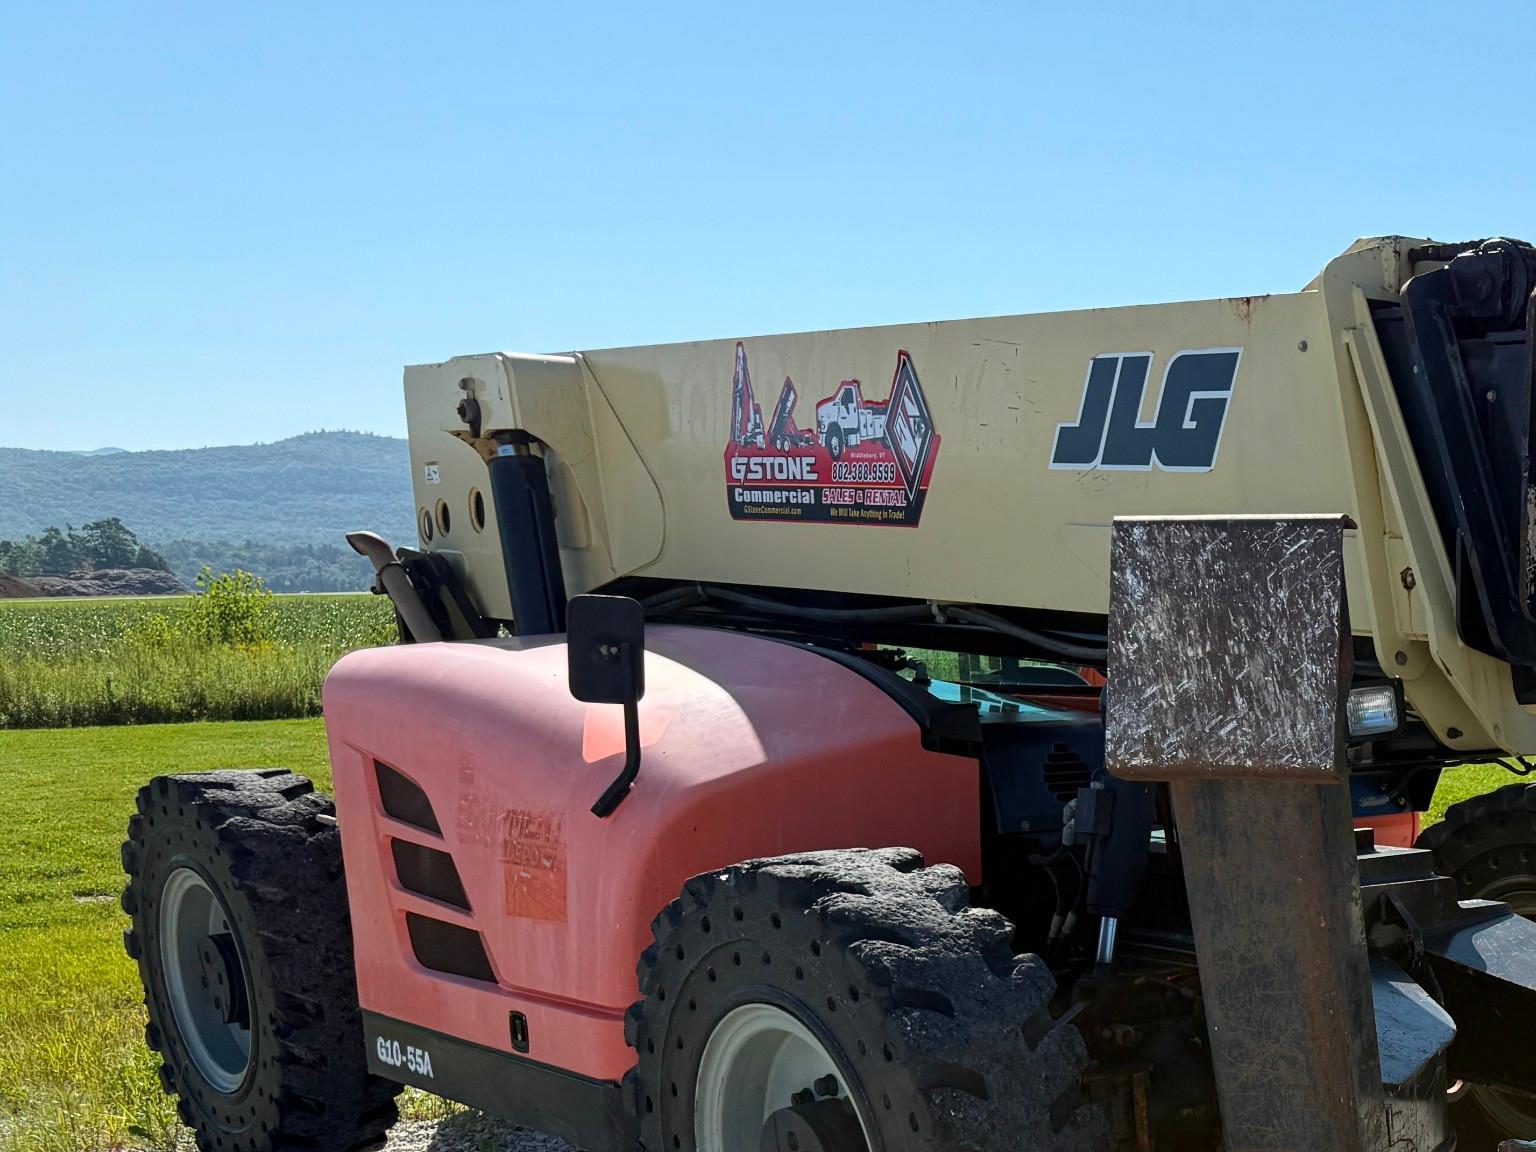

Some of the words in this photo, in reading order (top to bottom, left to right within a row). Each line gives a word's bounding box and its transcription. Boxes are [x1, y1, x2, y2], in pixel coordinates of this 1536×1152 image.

[1048, 347, 1244, 473] JLG
[731, 455, 818, 482] GSTONE
[832, 461, 896, 483] 802.388.9599
[734, 487, 815, 504] Commercial
[822, 488, 855, 505] SALES
[856, 490, 863, 503] &
[864, 489, 907, 507] RENTAL
[744, 505, 802, 515] GStoneCommercial.com
[831, 507, 838, 516] We
[838, 508, 849, 517] Will
[849, 508, 860, 518] Take
[861, 508, 882, 520] Anything
[888, 509, 905, 519] Trade!
[376, 1036, 434, 1079] G10-55A
